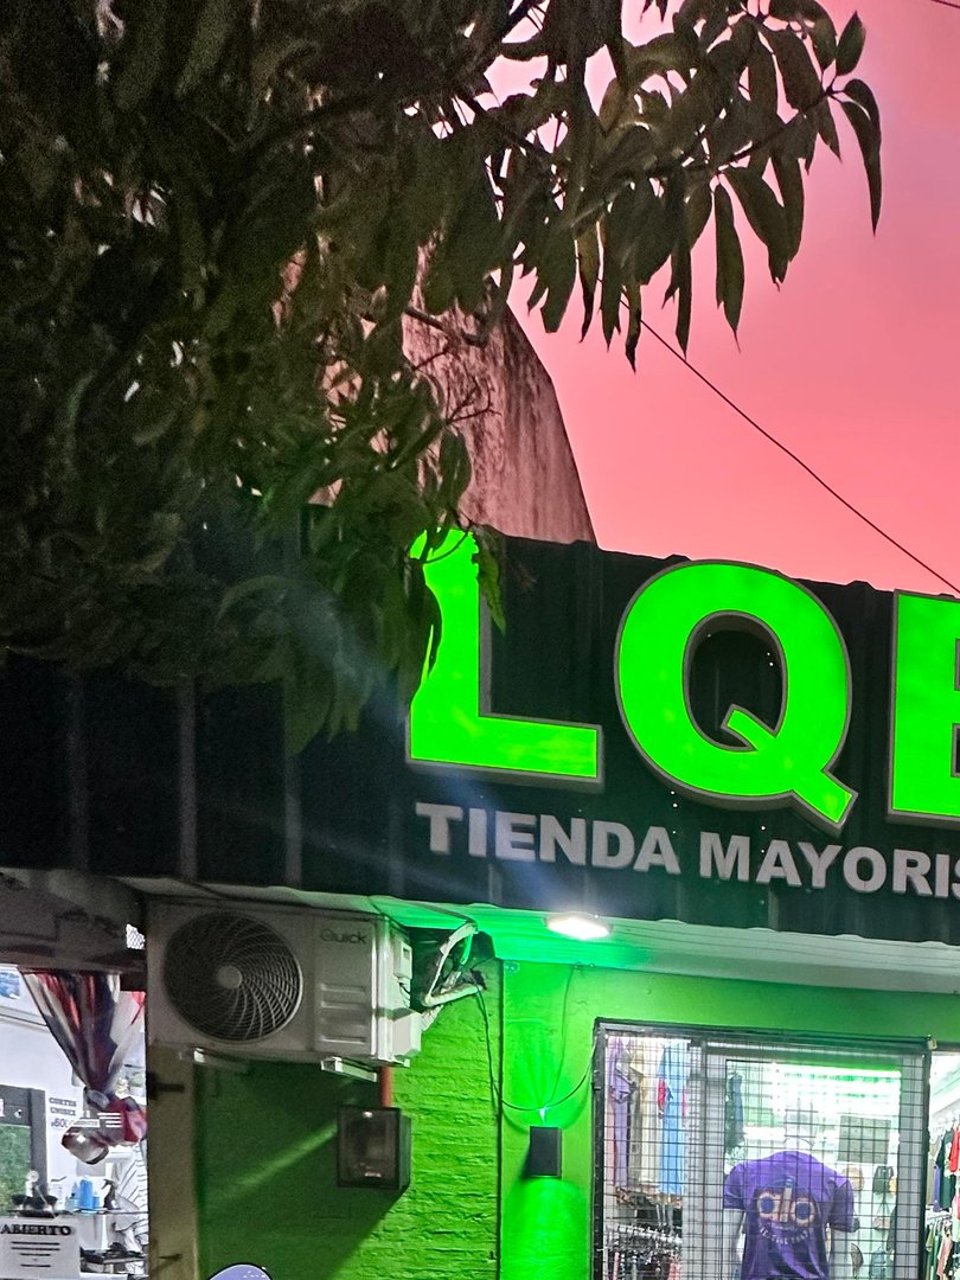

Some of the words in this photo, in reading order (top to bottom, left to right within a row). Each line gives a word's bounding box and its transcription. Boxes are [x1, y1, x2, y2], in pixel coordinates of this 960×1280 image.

[415, 802, 681, 874] TIENDA
[320, 928, 367, 944] Quick
[1, 1224, 72, 1236] ABIERTO
